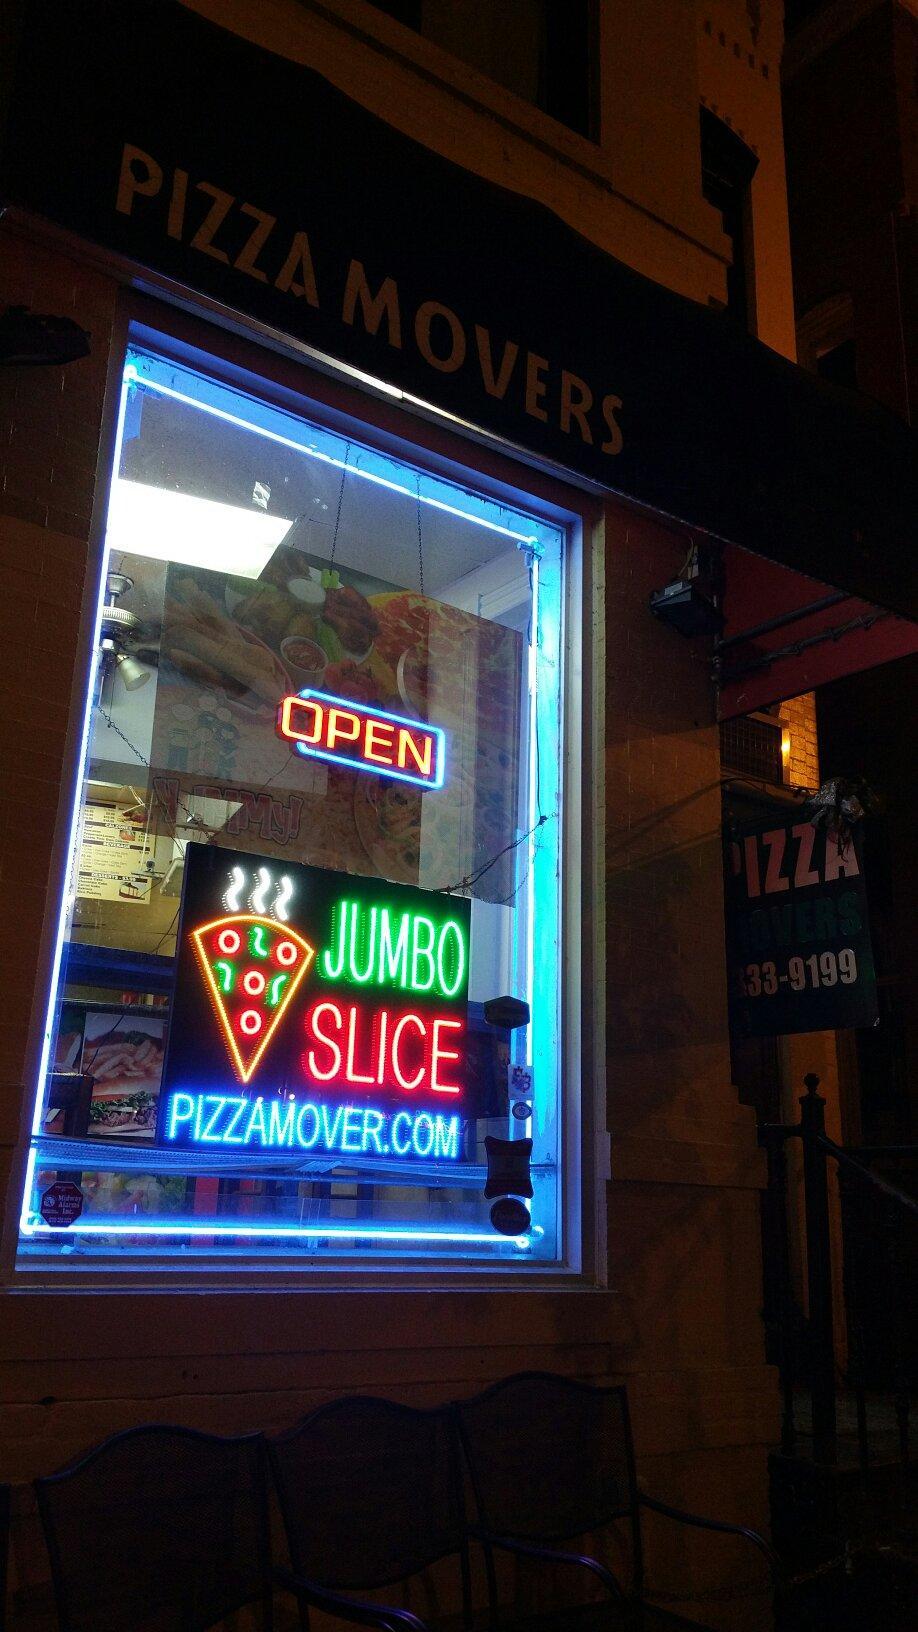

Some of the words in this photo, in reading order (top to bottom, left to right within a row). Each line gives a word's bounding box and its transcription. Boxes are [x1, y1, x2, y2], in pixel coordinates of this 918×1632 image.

[115, 142, 320, 309] PIZZA
[341, 257, 625, 456] MOVERS
[281, 696, 433, 775] OPEN
[324, 900, 465, 996] JUMBO
[308, 1002, 462, 1094] SLICE
[168, 1093, 461, 1158] PIZZAMOVER.COM
